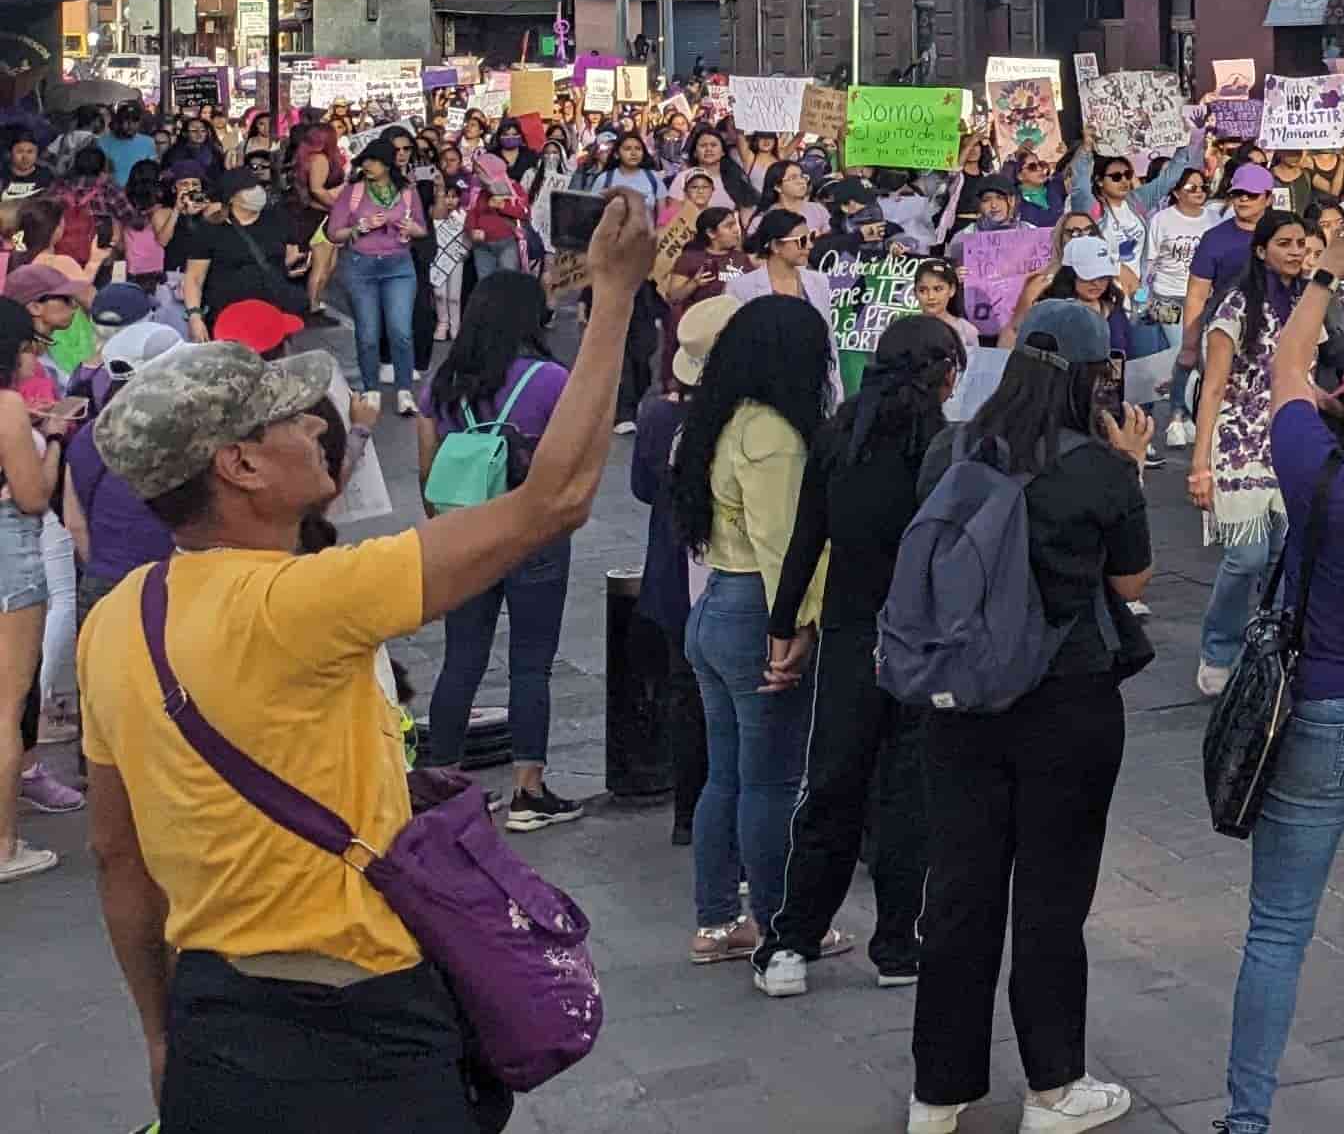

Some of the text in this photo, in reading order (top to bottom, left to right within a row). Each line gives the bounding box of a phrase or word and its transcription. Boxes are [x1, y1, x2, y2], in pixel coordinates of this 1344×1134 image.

[860, 95, 935, 125] Somos
[1286, 95, 1310, 113] HOY
[1287, 110, 1342, 125] EXISTIR
